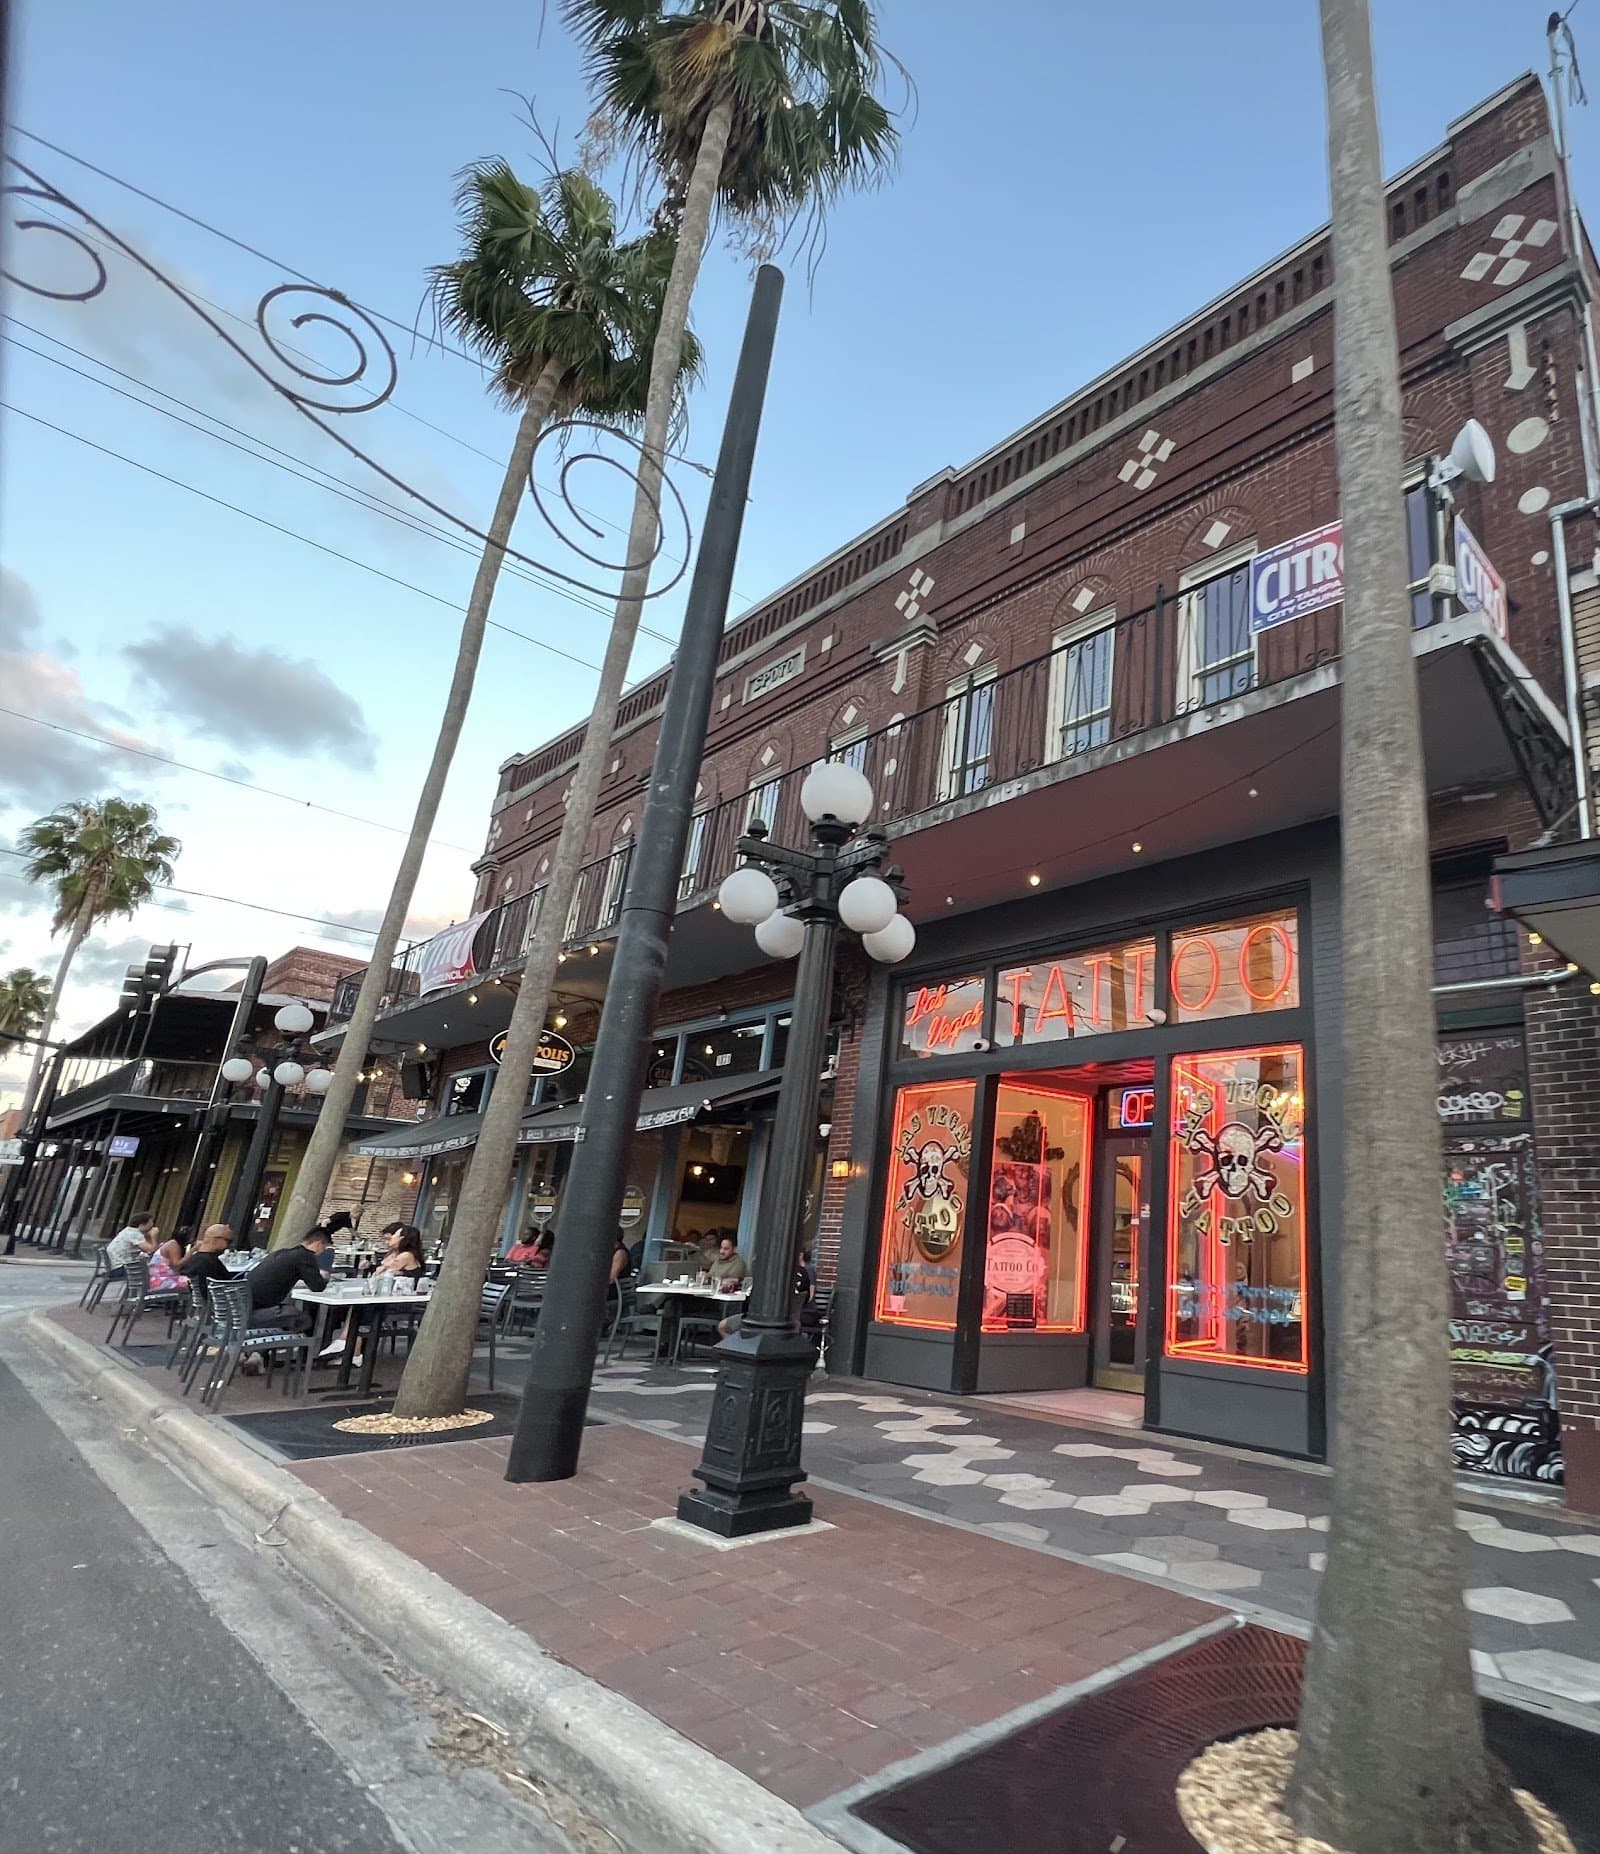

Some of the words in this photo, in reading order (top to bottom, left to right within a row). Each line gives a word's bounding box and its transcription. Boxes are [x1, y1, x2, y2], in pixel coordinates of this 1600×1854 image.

[1267, 606, 1296, 621] CITY
[1297, 587, 1345, 610] COUNC
[753, 658, 794, 692] SPOTO
[1005, 924, 1294, 1036] TATTOO
[906, 983, 948, 1025] Las
[926, 1000, 984, 1049] Vegas
[496, 1039, 570, 1062] APOLIS
[1126, 1093, 1154, 1123] OP
[1175, 1091, 1214, 1147] LAS
[895, 1114, 922, 1158] LAS
[926, 1104, 972, 1155] VEGAS
[895, 1194, 965, 1234] TATTOO
[1179, 1191, 1295, 1245] TATTOO
